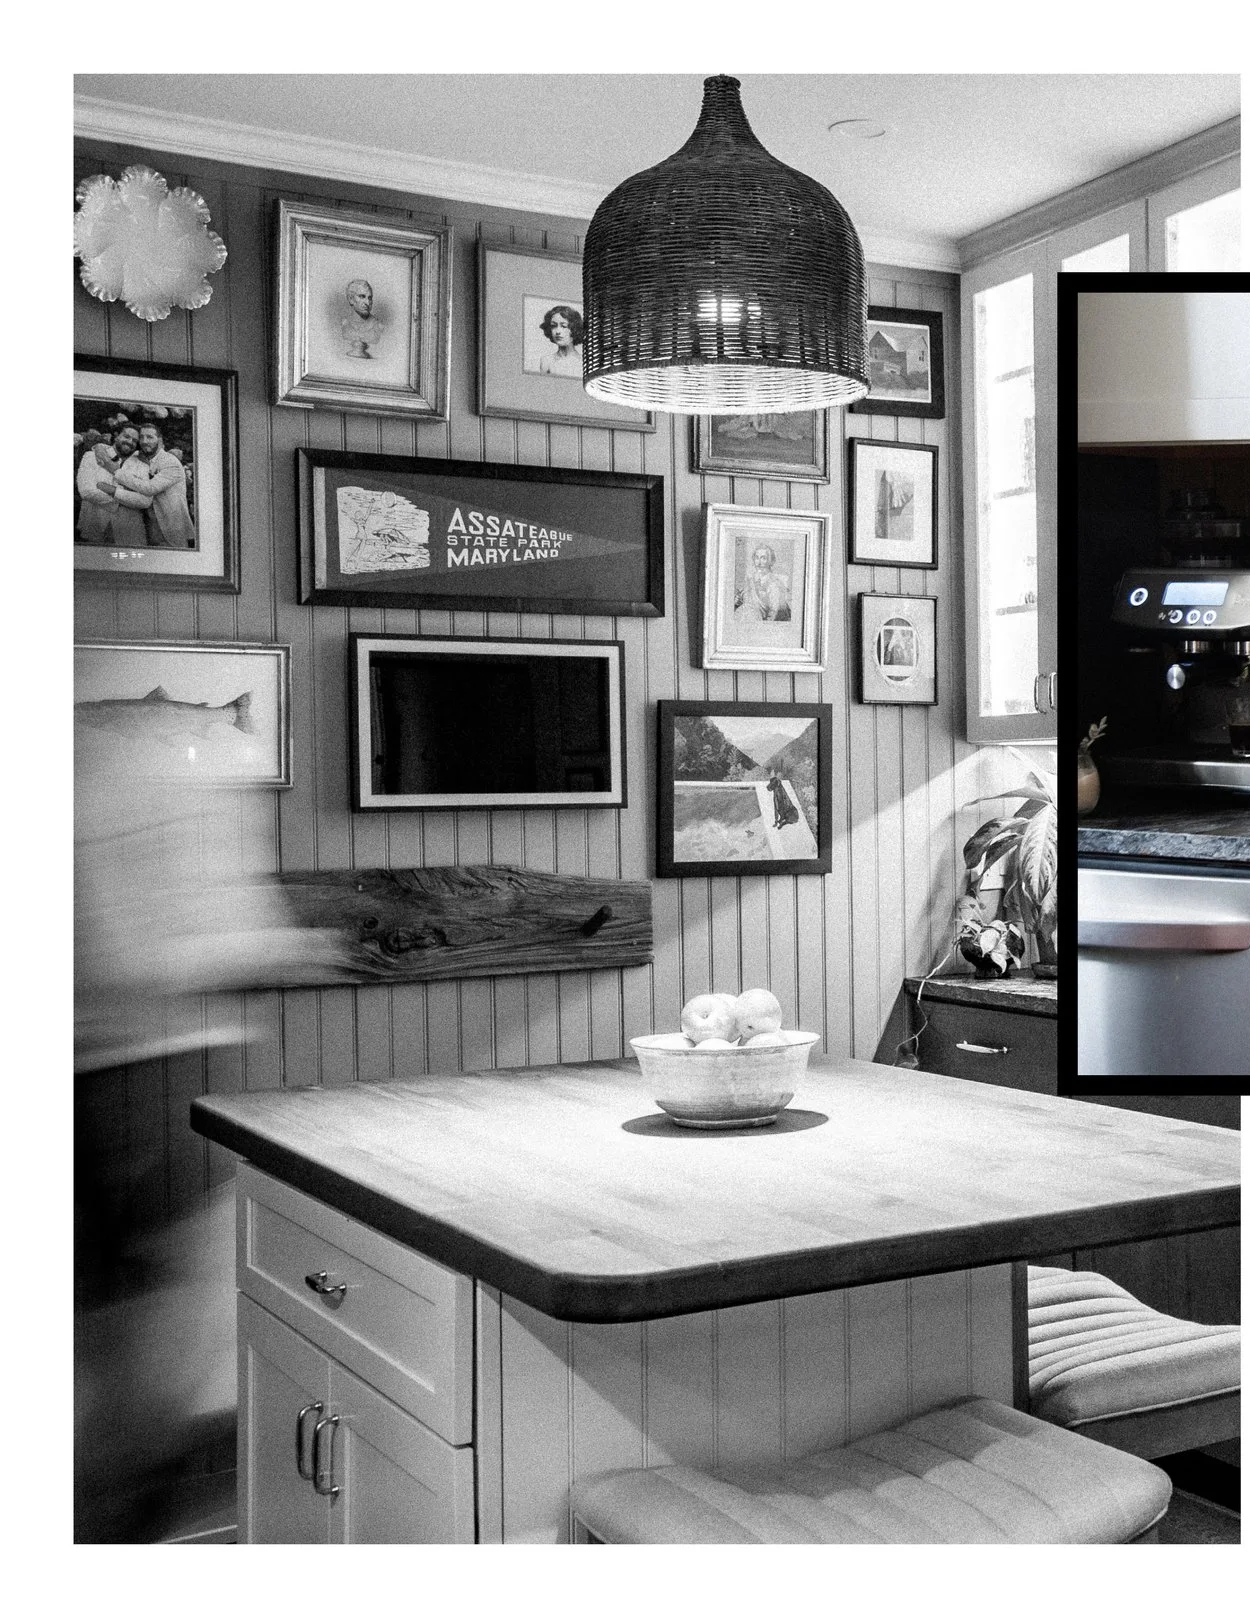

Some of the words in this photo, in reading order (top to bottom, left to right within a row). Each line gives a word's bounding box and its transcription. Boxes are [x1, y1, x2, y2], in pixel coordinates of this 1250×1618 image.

[447, 535, 508, 547] STATE
[517, 539, 562, 548] PARK
[447, 548, 559, 568] MARYLAND
